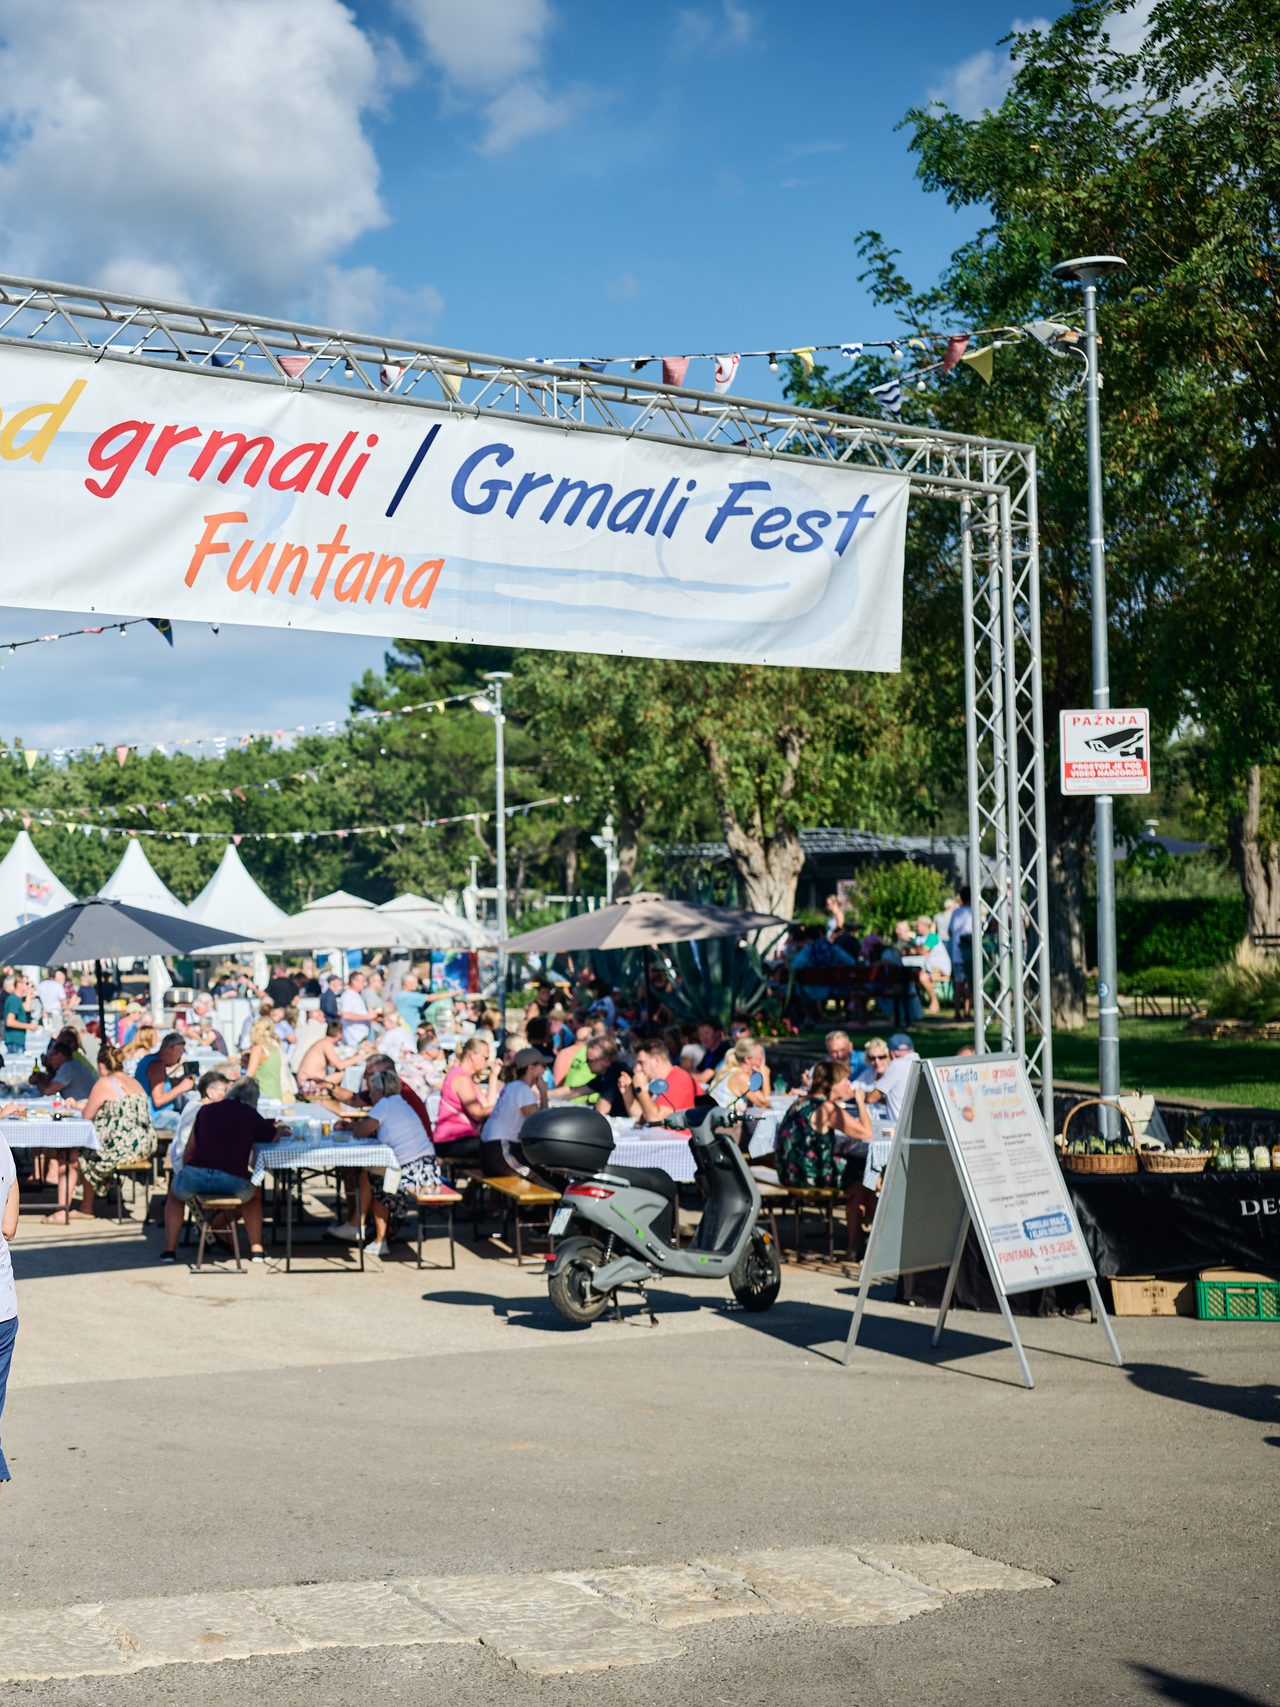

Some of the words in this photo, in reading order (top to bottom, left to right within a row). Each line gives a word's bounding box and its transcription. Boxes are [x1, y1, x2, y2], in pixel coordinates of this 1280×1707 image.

[84, 419, 379, 500] grmali
[385, 424, 442, 518] /
[450, 443, 697, 538] Grmali
[704, 480, 877, 557] Fest
[184, 511, 445, 609] Funtana
[1072, 715, 1138, 726] PAŽNJA
[1240, 1198, 1280, 1216] DE
